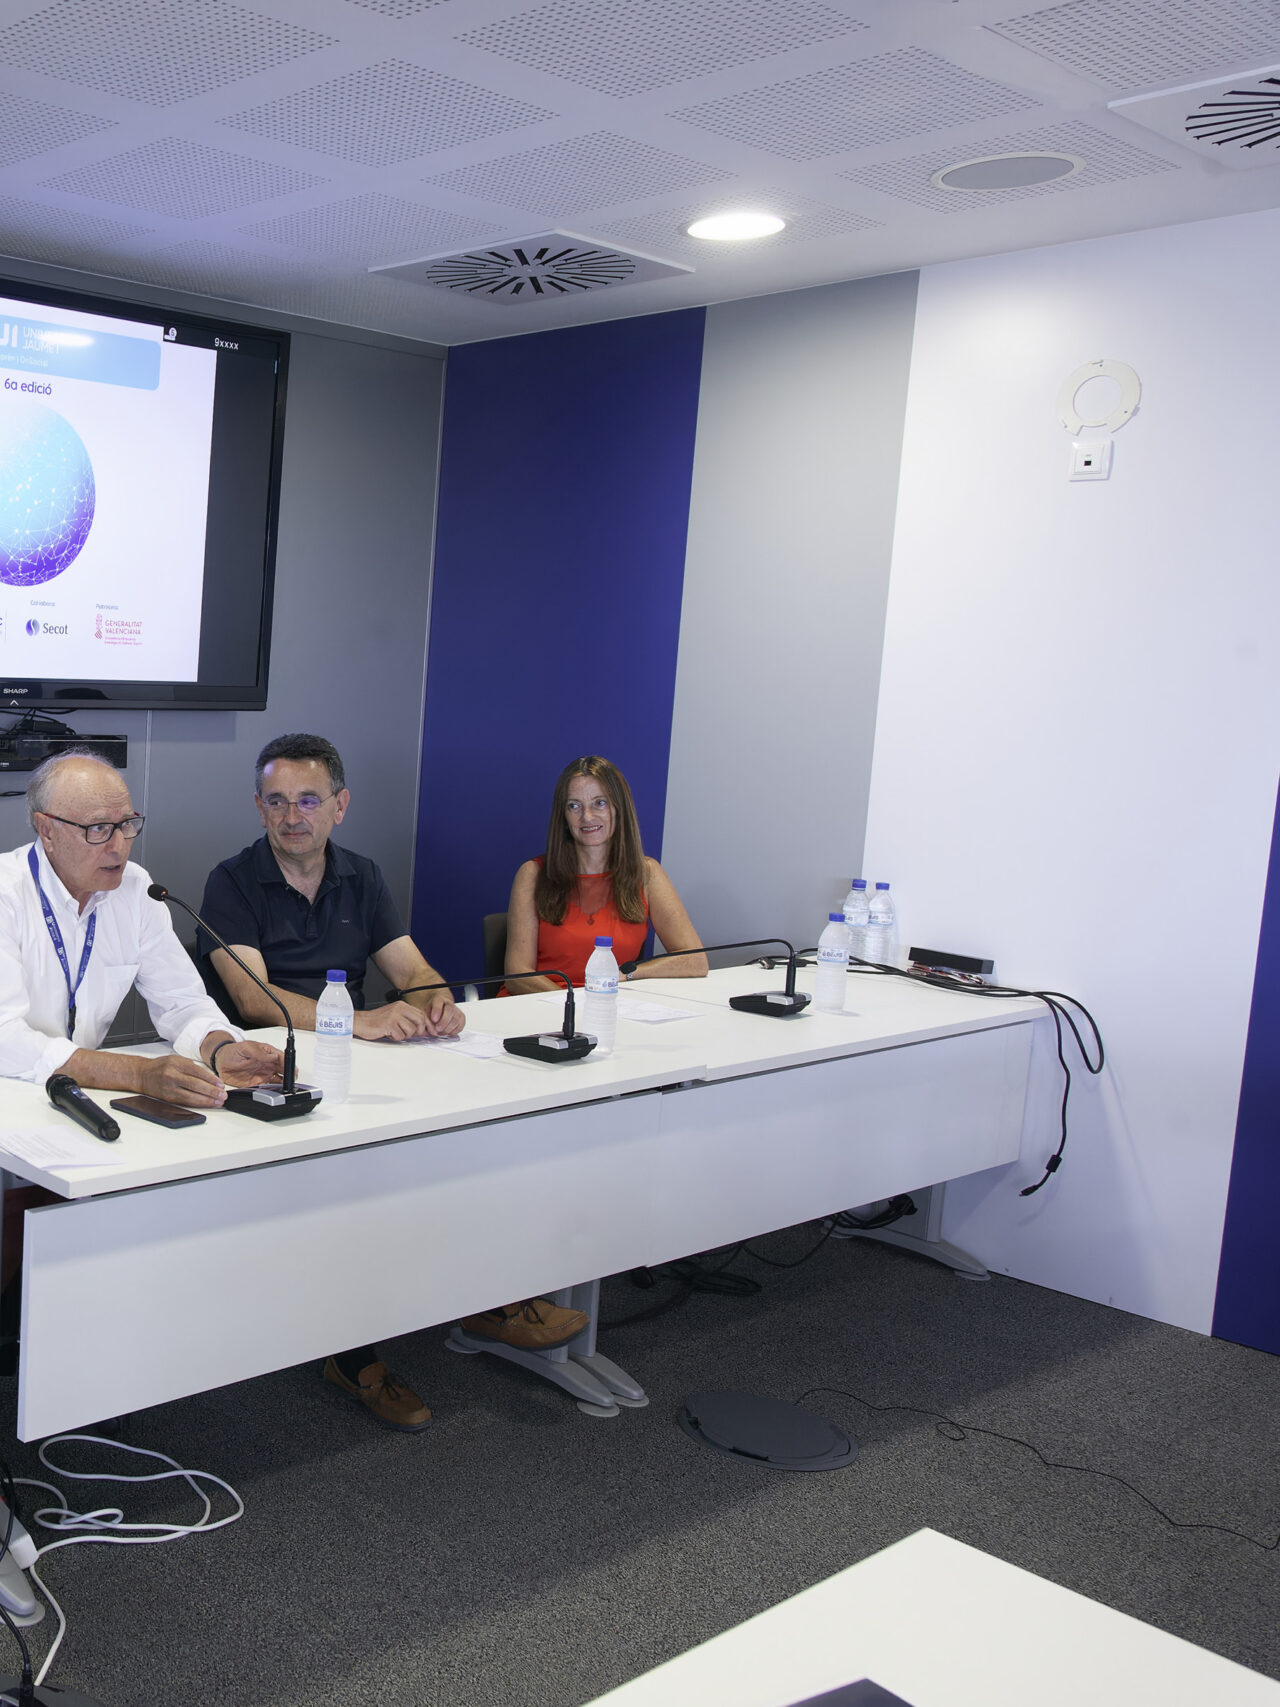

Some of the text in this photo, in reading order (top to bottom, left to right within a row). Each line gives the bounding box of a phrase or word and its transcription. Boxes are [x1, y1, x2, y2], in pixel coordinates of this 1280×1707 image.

[214, 337, 239, 350] 9xxxx
[4, 378, 52, 395] 6a edició
[42, 622, 68, 635] Secot
[104, 619, 143, 628] GENERALITAT
[105, 627, 141, 635] VALENCIANA
